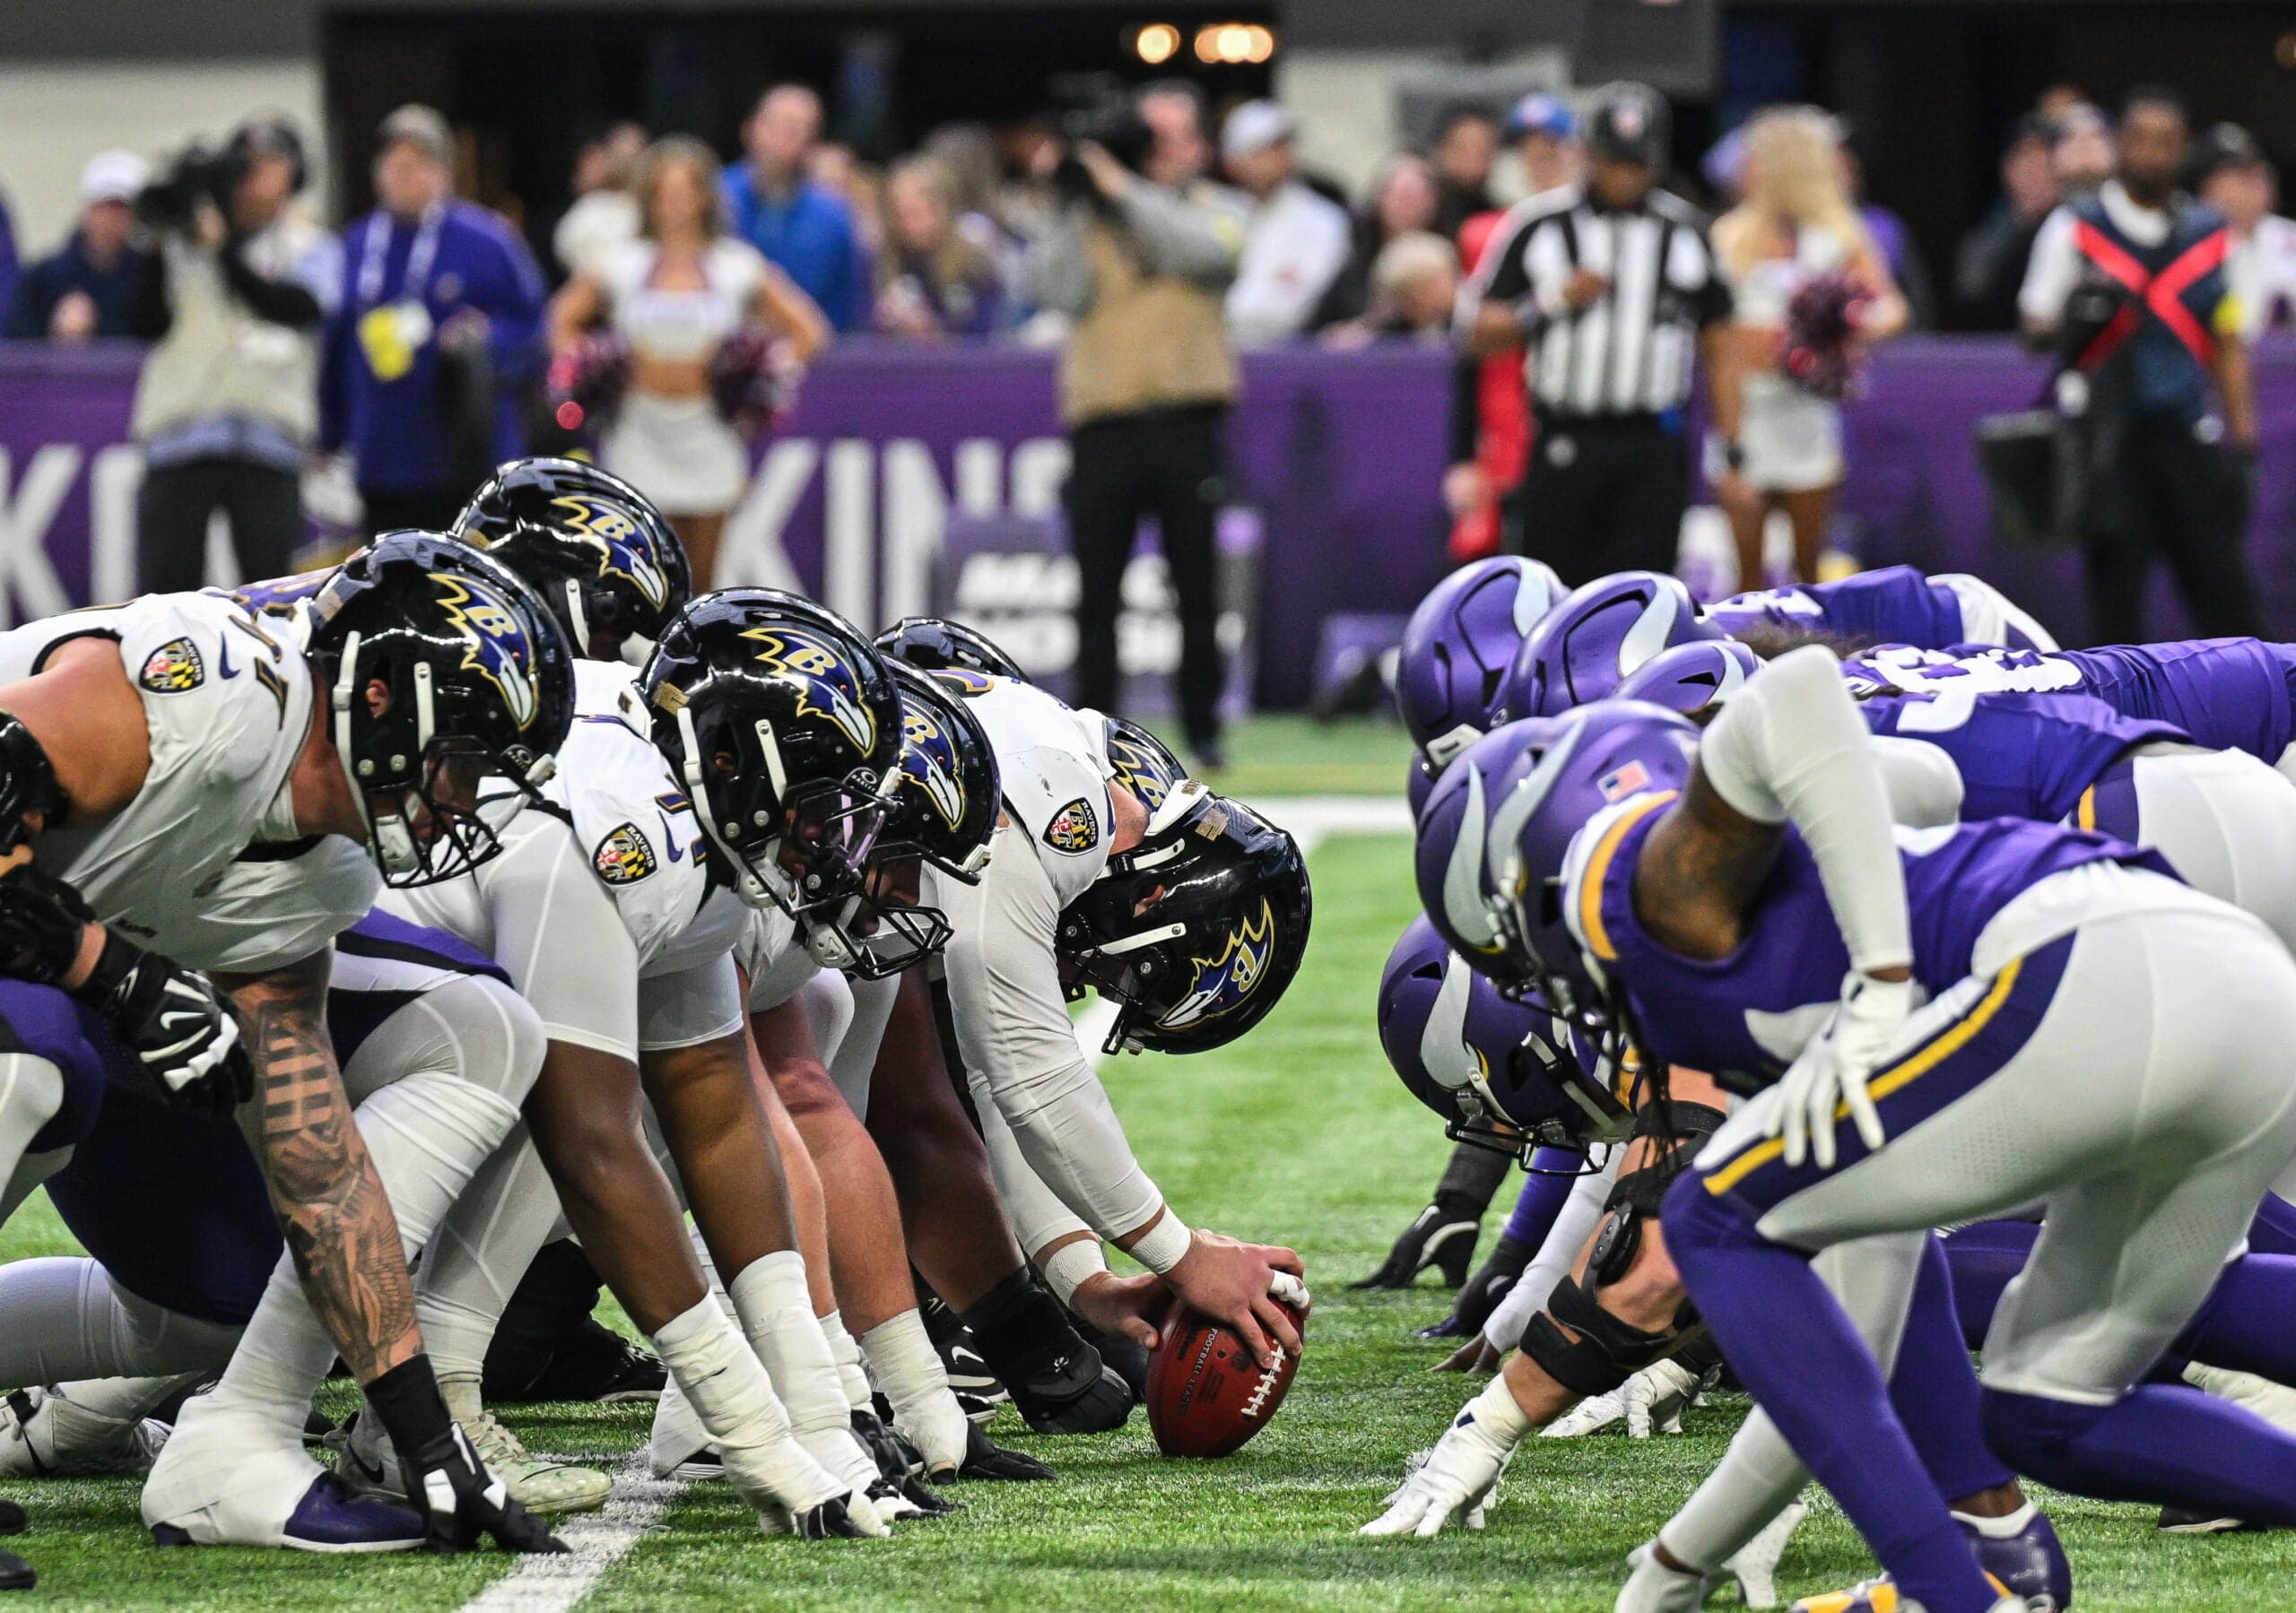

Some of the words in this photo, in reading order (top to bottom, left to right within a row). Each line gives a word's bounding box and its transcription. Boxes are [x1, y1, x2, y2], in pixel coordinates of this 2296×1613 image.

[587, 515, 636, 542] B
[463, 605, 517, 637] B
[781, 647, 837, 676] B
[1081, 801, 1097, 843] RAVENS
[627, 825, 655, 868] RAVENS
[1231, 941, 1257, 993] B
[1193, 1327, 1219, 1375] FOOTBALL
